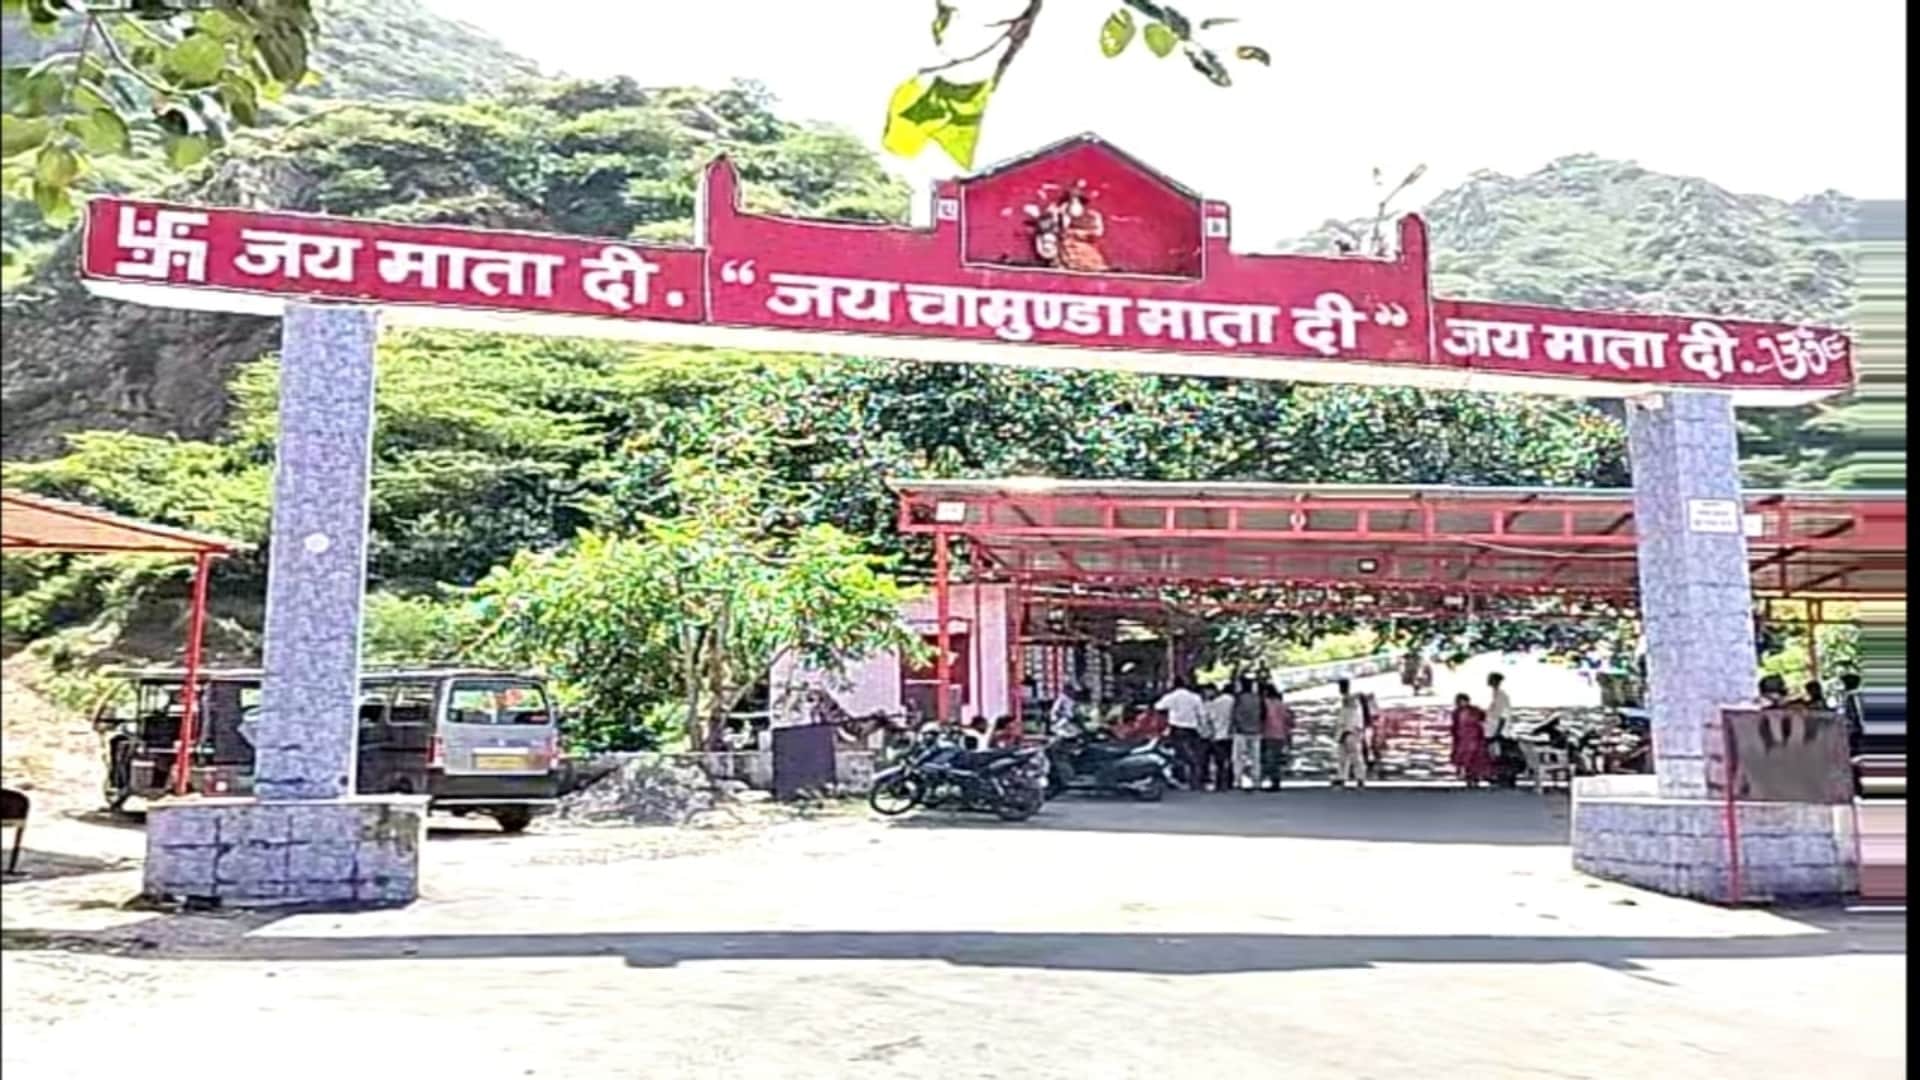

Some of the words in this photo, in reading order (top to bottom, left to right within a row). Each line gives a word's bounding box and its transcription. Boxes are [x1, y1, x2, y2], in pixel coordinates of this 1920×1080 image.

[235, 230, 362, 282] जय
[377, 241, 565, 297] माता
[905, 284, 1132, 340] चामुण्डा
[1137, 299, 1281, 347] माता
[1443, 319, 1534, 360] जय
[1542, 325, 1669, 370] माता
